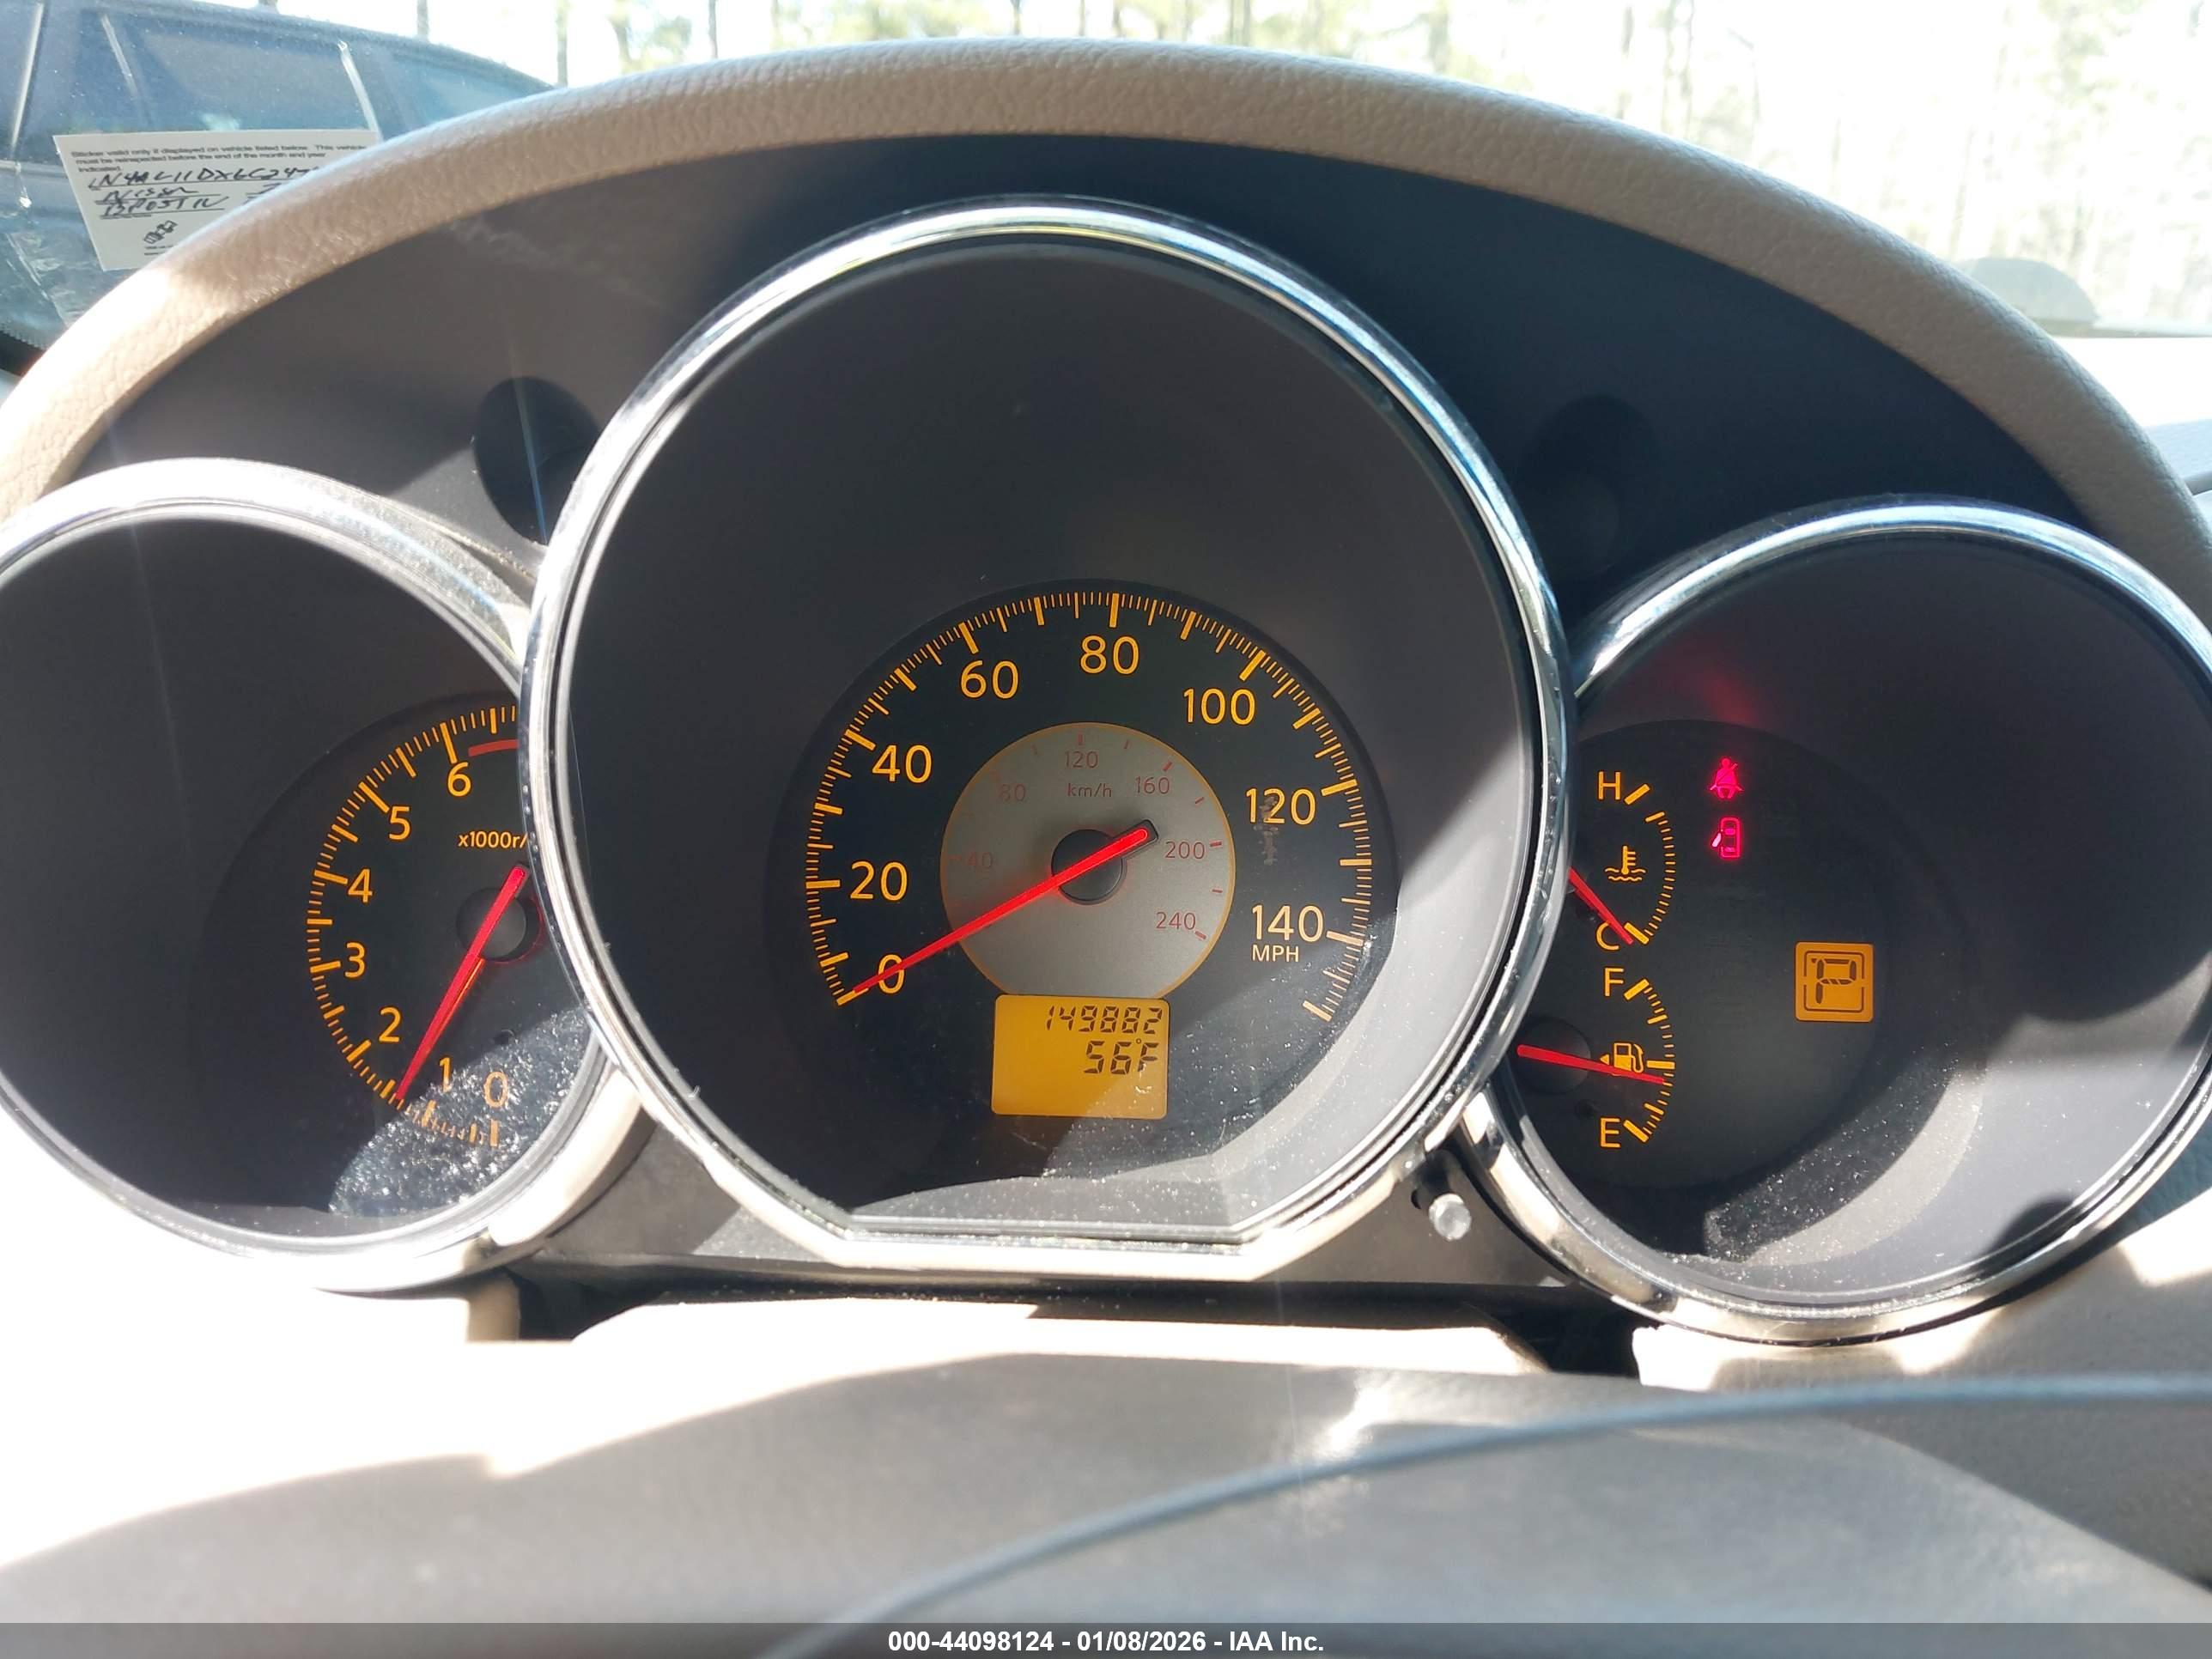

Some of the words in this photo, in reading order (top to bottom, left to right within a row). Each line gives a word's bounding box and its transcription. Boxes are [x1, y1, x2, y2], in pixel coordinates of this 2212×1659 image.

[1080, 635, 1139, 675] 80
[960, 659, 1018, 699] 60
[1183, 688, 1255, 726] 100
[872, 744, 933, 783] 40
[1065, 750, 1099, 769] 120
[447, 762, 471, 797] 6
[1067, 782, 1113, 798] km/h
[1135, 776, 1170, 794] 160
[1598, 771, 1622, 800] H
[389, 805, 411, 841] 5
[1247, 787, 1316, 825] 120
[1164, 842, 1206, 860] 200
[347, 868, 374, 903] 4
[850, 860, 908, 901] 20
[1156, 911, 1197, 930] 240
[1252, 905, 1324, 944] 140
[1595, 921, 1620, 951] C
[344, 942, 366, 978] 3
[1251, 944, 1300, 963] MPH
[878, 954, 906, 994] 0
[1603, 968, 1625, 998] F
[1810, 957, 1857, 1005] P
[378, 1006, 401, 1043] 2
[1046, 1005, 1164, 1035] 149882
[438, 1057, 452, 1092] 1
[483, 1072, 509, 1108] 0
[1600, 1117, 1621, 1148] E
